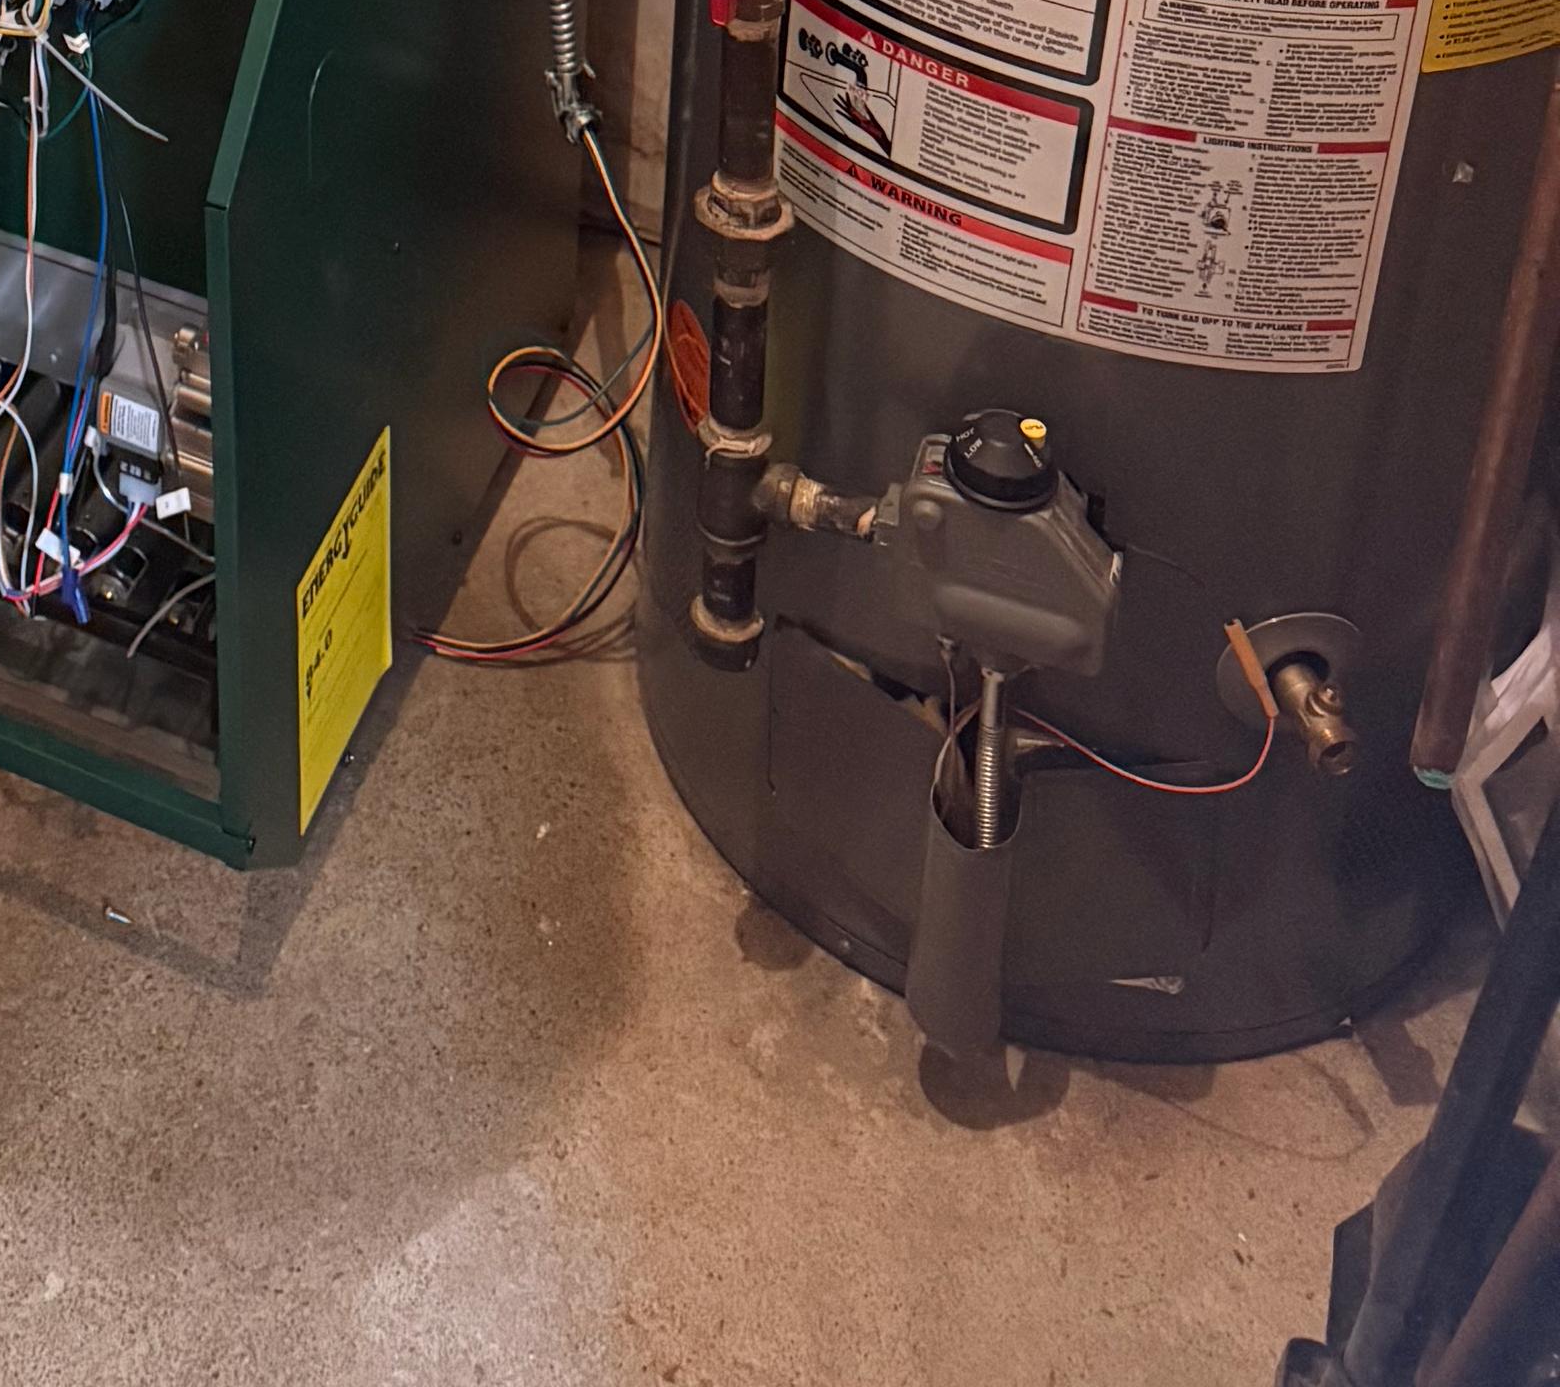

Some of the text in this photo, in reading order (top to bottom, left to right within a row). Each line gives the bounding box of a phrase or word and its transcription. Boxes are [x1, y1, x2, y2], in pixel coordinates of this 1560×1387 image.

[1291, 0, 1327, 8] BEFORE
[1329, 0, 1379, 9] OPERATING
[883, 39, 969, 88] DANGER
[1203, 137, 1312, 153] LIGHTING INSTRUCTIONS
[870, 175, 962, 226] WARNING
[1142, 306, 1304, 332] TO TURN GAS OFF TO THE APPLIANCE
[955, 427, 974, 442] HOT
[964, 437, 982, 458] LOW
[302, 448, 387, 619] ENERGYGUIDE
